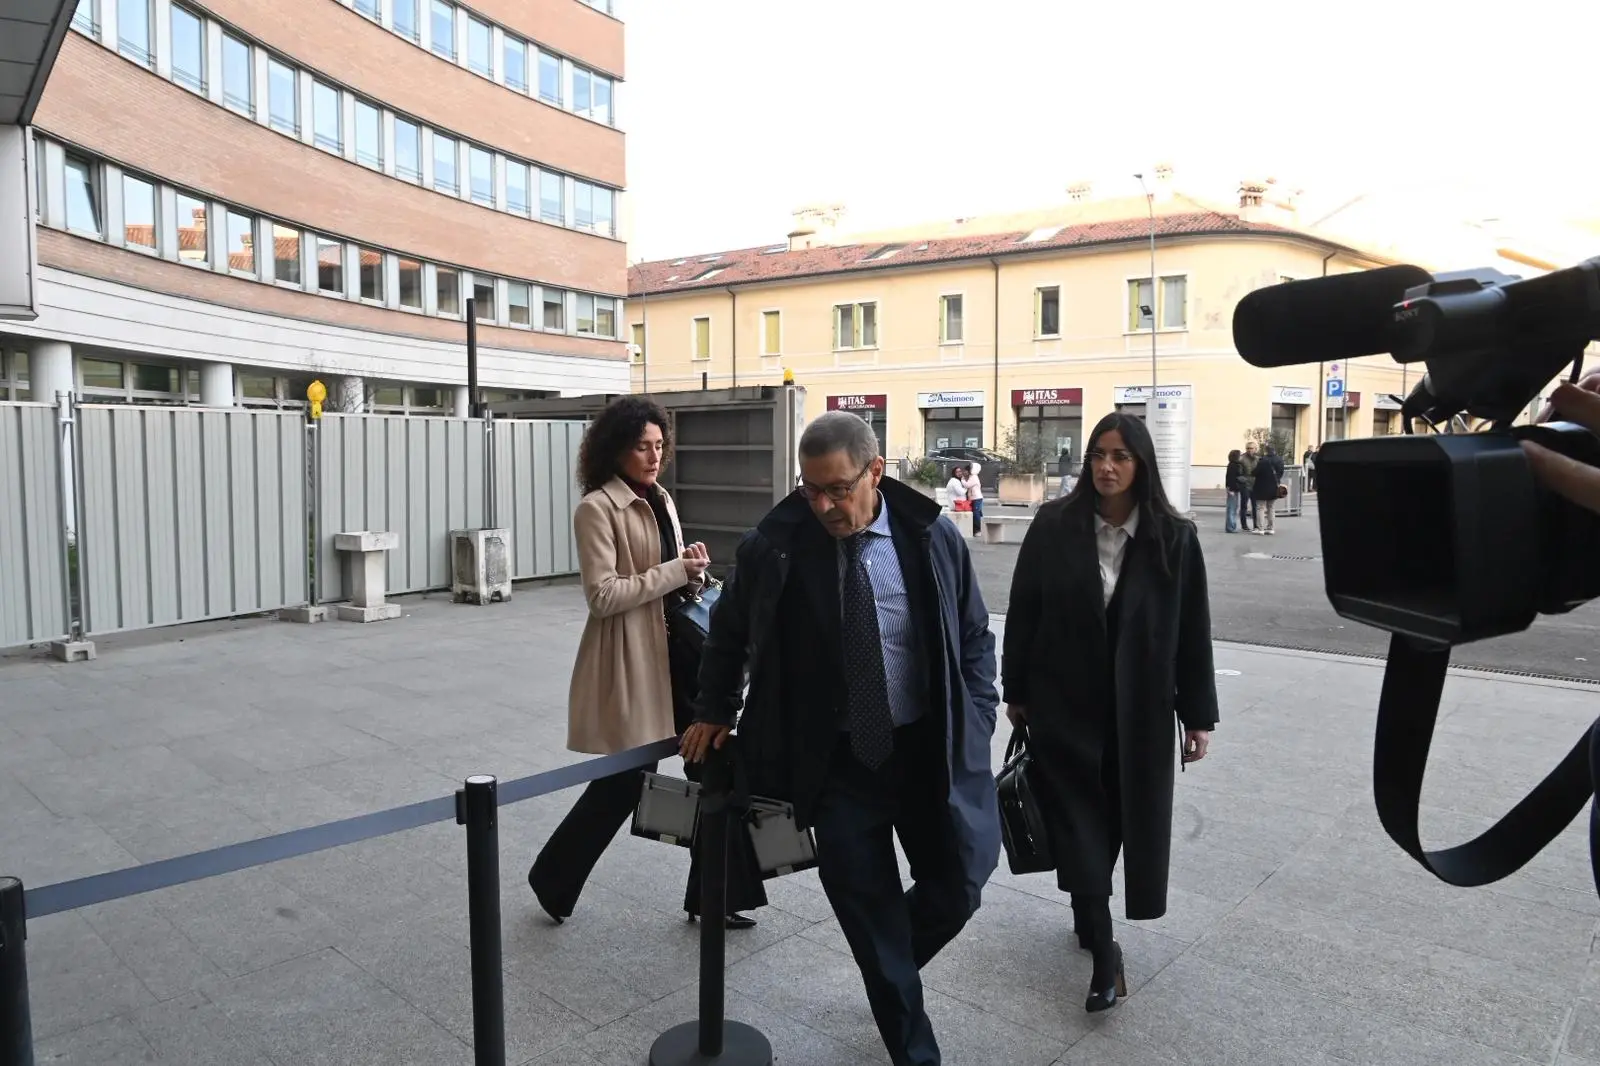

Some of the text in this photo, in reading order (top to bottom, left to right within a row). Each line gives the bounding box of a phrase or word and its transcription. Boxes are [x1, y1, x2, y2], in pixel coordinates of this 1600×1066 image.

[1329, 381, 1339, 395] P
[937, 393, 974, 402] Assimoco
[1035, 390, 1058, 400] ITAS
[848, 396, 866, 405] ITAS
